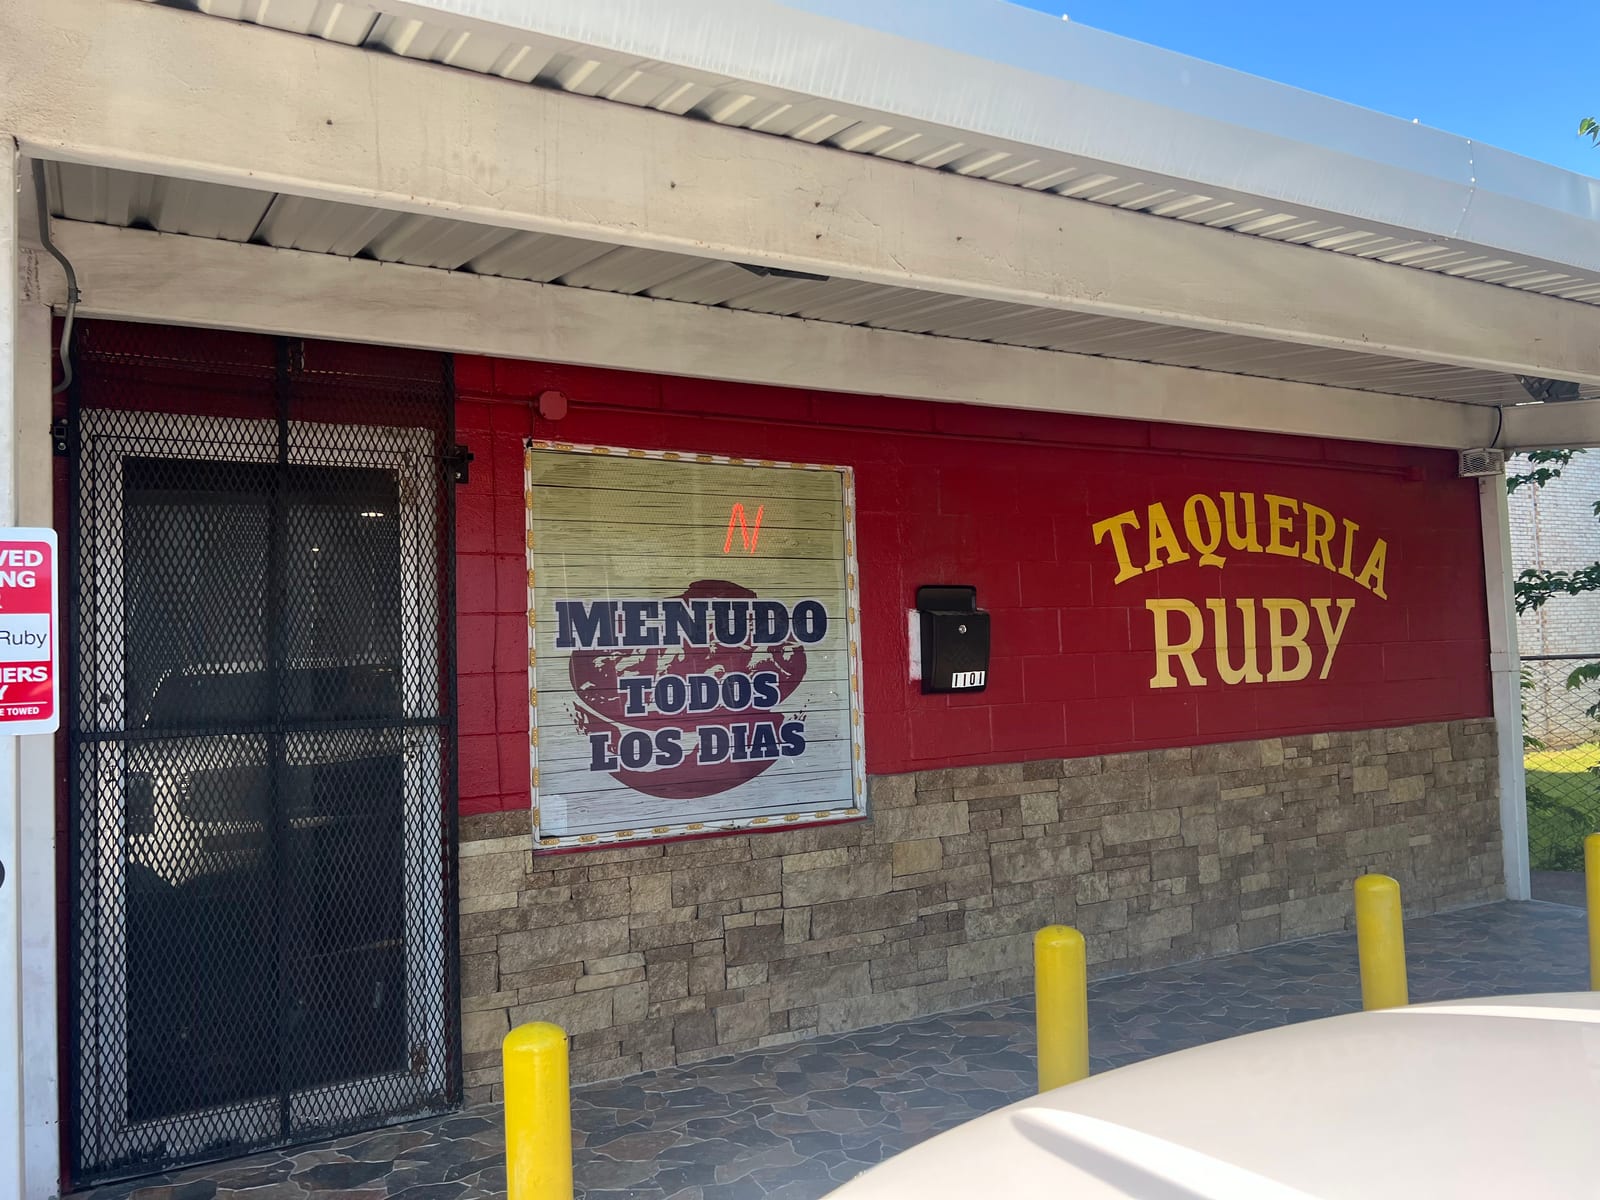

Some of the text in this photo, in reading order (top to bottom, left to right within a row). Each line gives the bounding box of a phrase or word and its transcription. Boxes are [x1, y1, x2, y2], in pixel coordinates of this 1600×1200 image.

[1092, 491, 1387, 600] TAQUERIA
[555, 600, 828, 649] MENUDO
[1145, 598, 1355, 688] RUBY
[619, 672, 779, 716] TODOS
[954, 672, 983, 687] 1101
[6, 706, 40, 716] TOWED
[589, 721, 806, 772] LOS DIAS
